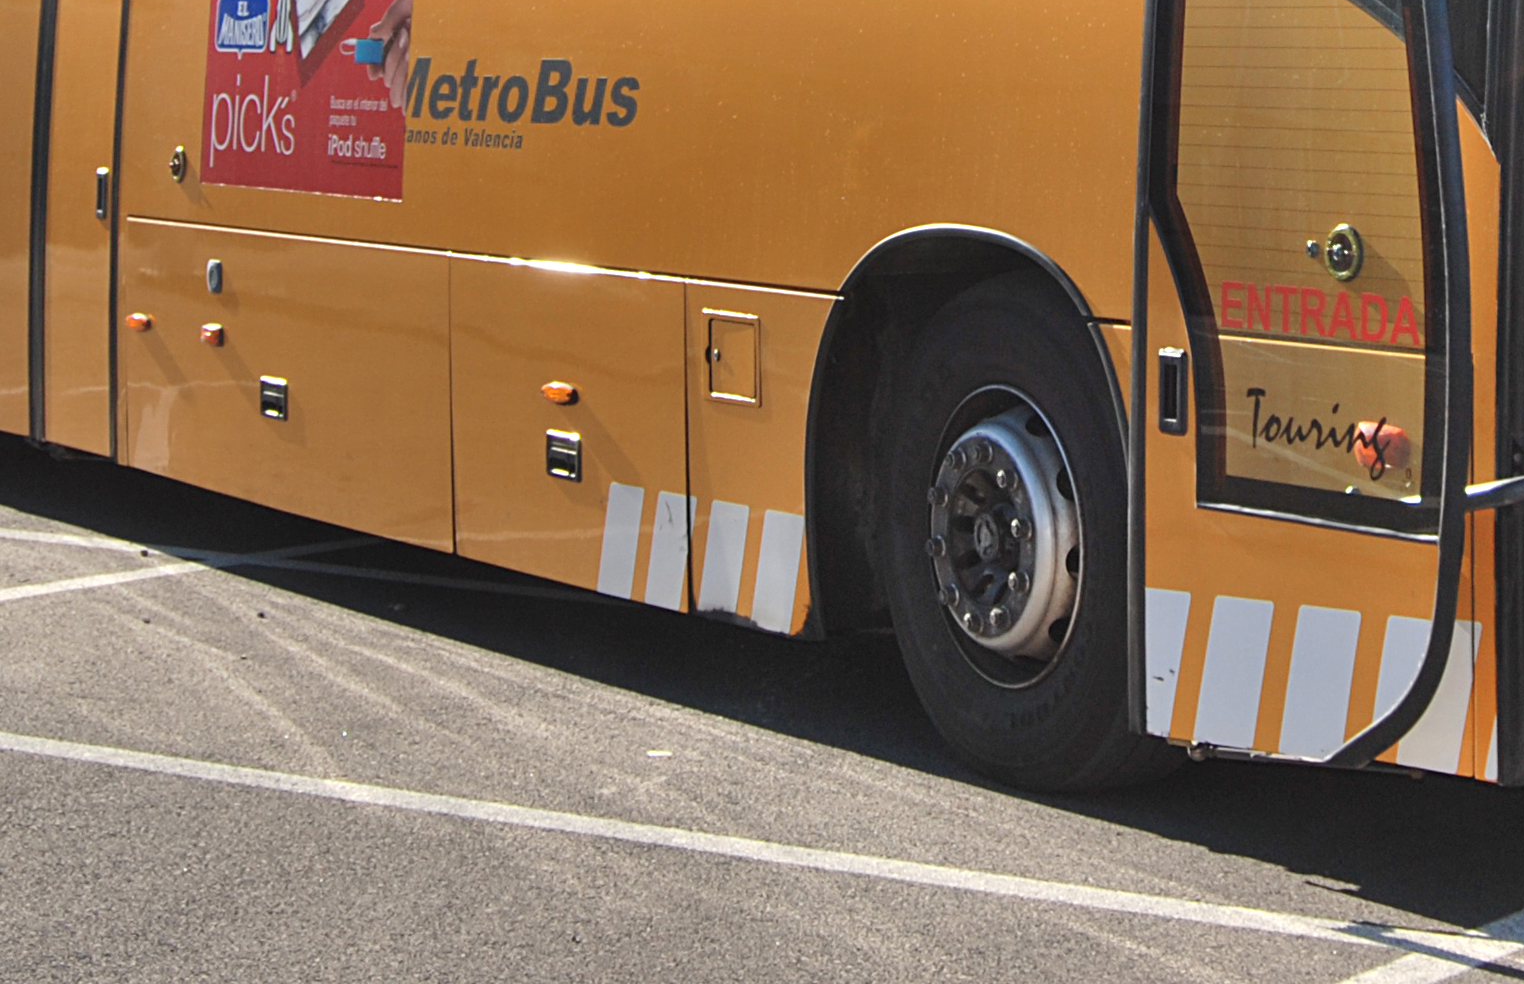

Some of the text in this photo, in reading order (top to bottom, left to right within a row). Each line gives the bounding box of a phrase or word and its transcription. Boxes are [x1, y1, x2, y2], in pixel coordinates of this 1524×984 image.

[236, 0, 250, 17] EL
[328, 133, 353, 156] iPod
[403, 126, 524, 149] anos de Valencia
[1220, 280, 1421, 346] ENTRADA
[1245, 387, 1392, 482] Touring
